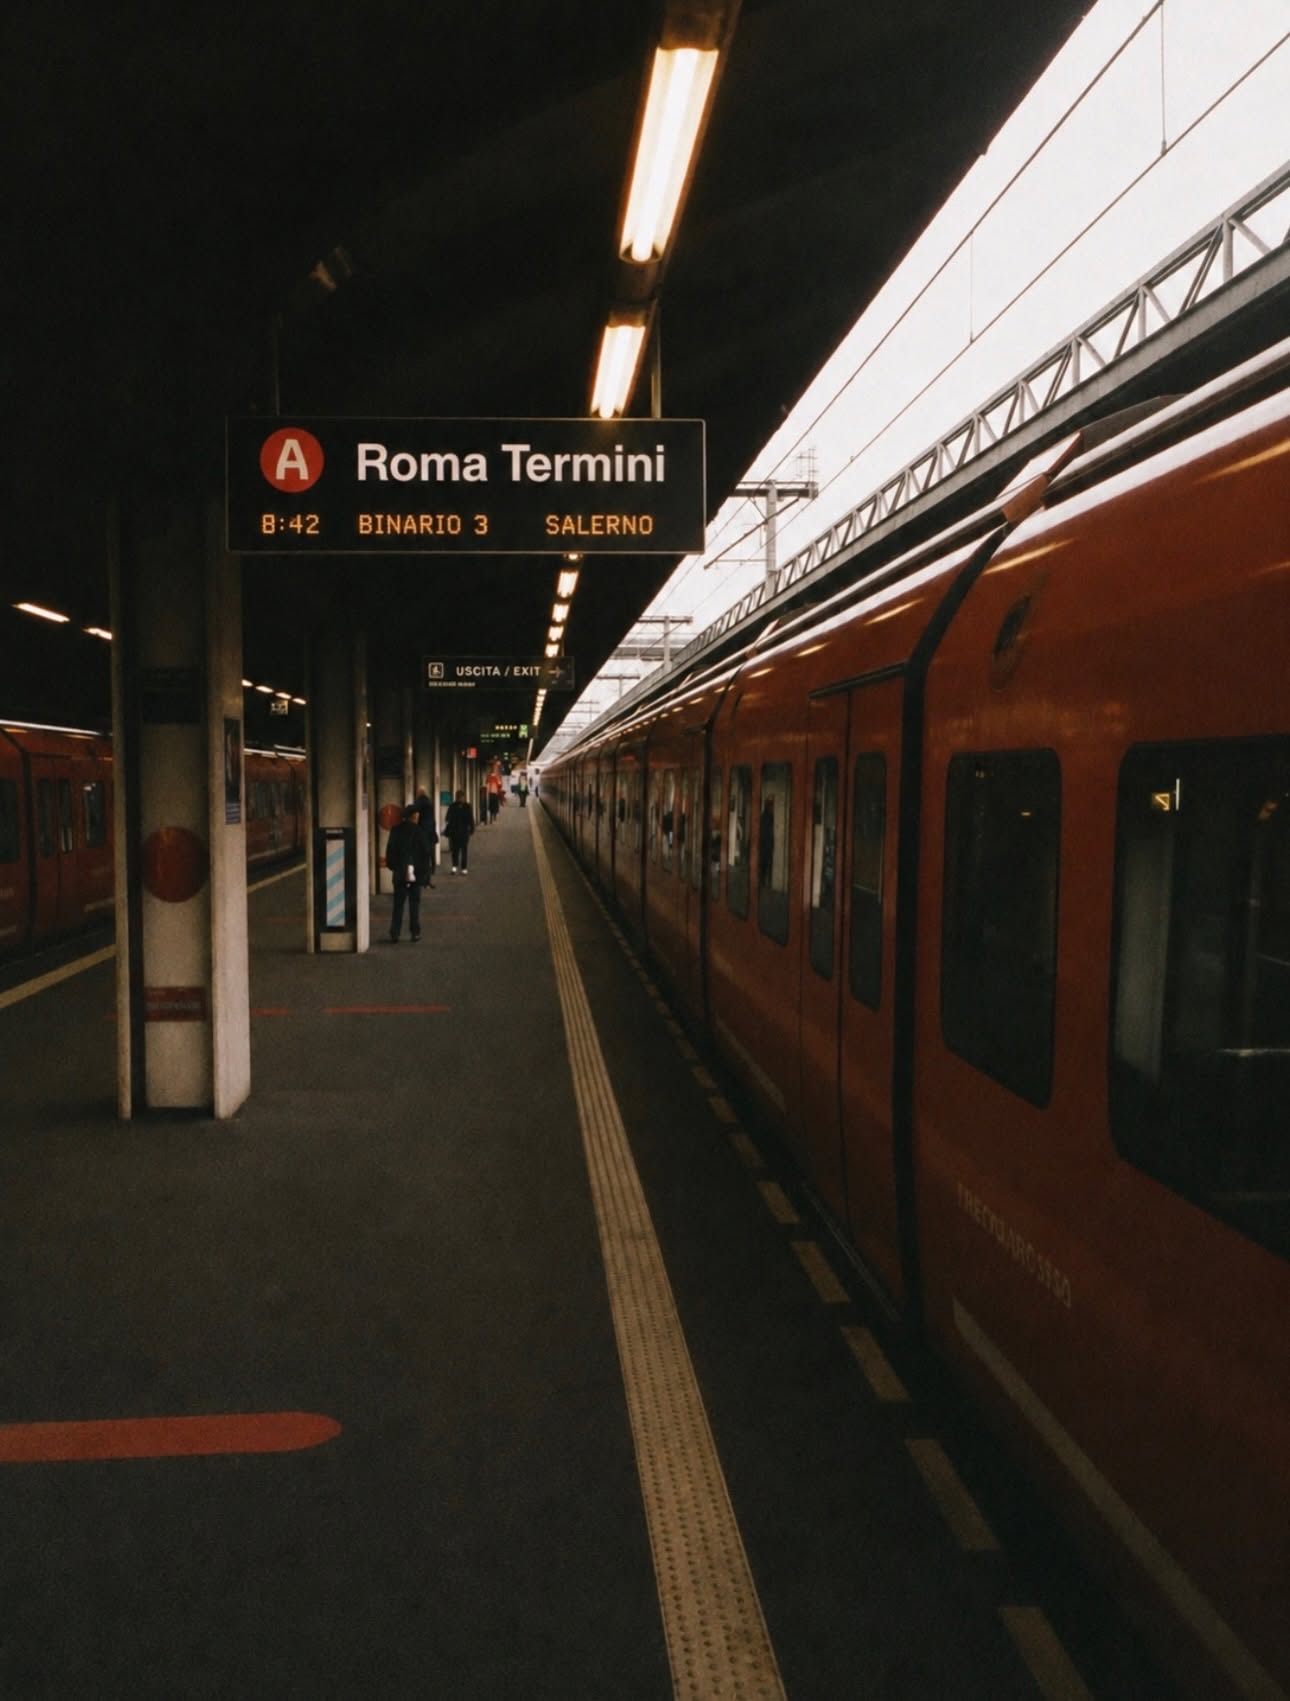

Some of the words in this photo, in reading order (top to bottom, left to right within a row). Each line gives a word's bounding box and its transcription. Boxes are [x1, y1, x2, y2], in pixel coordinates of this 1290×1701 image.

[275, 438, 309, 481] A
[357, 442, 488, 482] Roma
[501, 443, 665, 482] Termini
[261, 513, 320, 536] 8:42
[358, 513, 462, 536] BINARIO
[474, 513, 489, 536] 3
[545, 514, 654, 536] SALERNO
[455, 666, 501, 677] USCITA
[513, 666, 542, 677] EXIT
